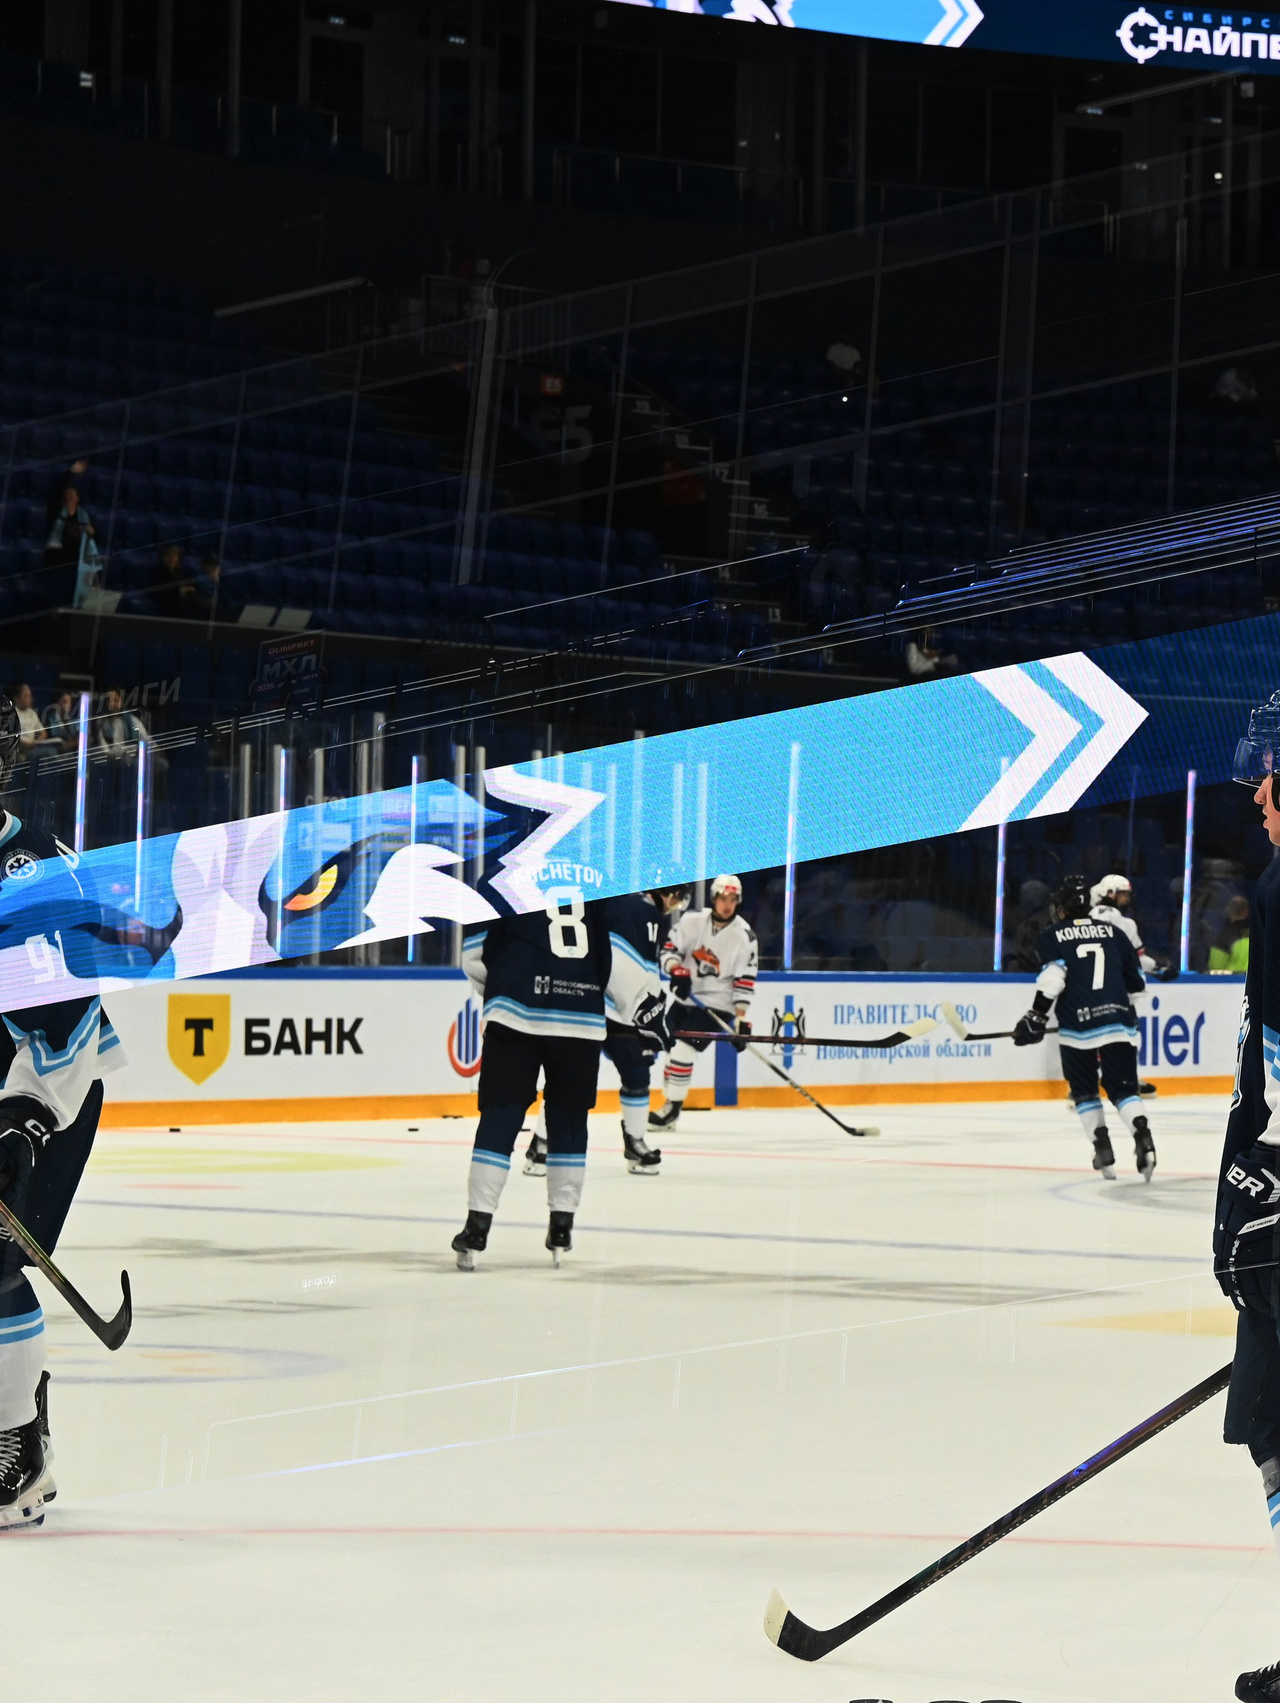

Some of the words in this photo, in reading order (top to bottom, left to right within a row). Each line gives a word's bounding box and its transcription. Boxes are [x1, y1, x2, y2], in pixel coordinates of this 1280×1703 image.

[262, 654, 317, 681] МХЛ
[518, 861, 604, 889] OCHETOV
[545, 885, 589, 960] 8
[1055, 925, 1115, 943] KOKOREV
[24, 930, 69, 985] 91
[1076, 942, 1106, 991] 7
[833, 1003, 978, 1025] ПРАВИТЕЛЬСВО
[184, 1018, 214, 1057] Т
[244, 1017, 364, 1057] БАНК
[936, 1037, 992, 1059] области
